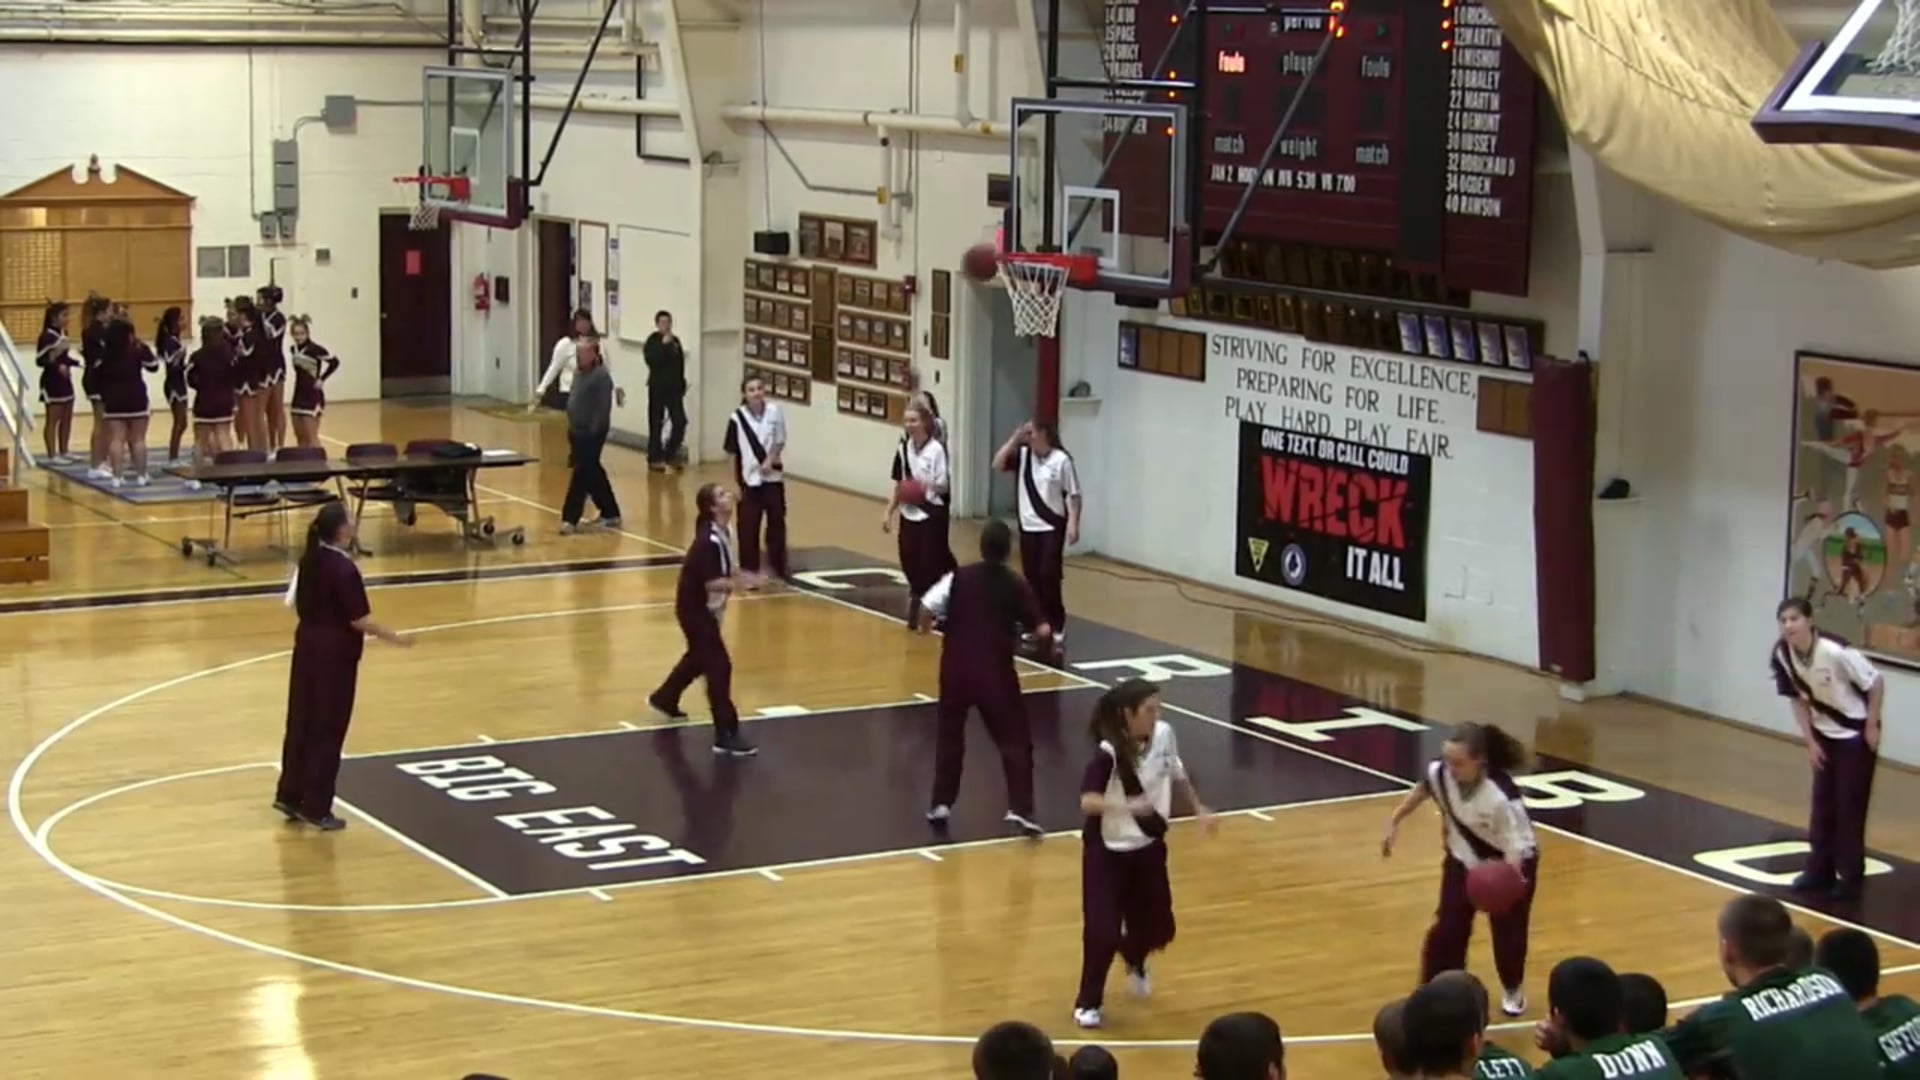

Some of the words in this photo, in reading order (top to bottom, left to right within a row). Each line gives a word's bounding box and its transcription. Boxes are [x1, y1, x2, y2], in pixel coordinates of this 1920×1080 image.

[1465, 27, 1503, 47] MARTIN
[1218, 50, 1246, 73] fouls
[1361, 55, 1391, 78] fouls
[1450, 69, 1463, 88] 20
[1464, 70, 1501, 90] BRALEY
[1449, 90, 1462, 109] 22
[1464, 90, 1500, 111] MARTIN
[1214, 133, 1245, 154] match
[1280, 136, 1318, 161] weight
[1355, 144, 1390, 165] match
[1445, 173, 1458, 192] 34
[1459, 175, 1491, 194] OGDEN
[1445, 194, 1459, 214] 40
[1460, 195, 1501, 217] RAWSON
[1211, 333, 1288, 366] STRIVING
[1301, 347, 1336, 374] FOR
[1350, 355, 1477, 400] EXCELLENCE,
[1236, 367, 1333, 405] PREPARING
[1345, 386, 1380, 413] FOR
[1396, 394, 1445, 425] LIFE.
[1224, 396, 1267, 423] PLAY
[1345, 417, 1392, 447] PLAY
[1261, 429, 1284, 450] ONE
[1287, 434, 1317, 457] TEXT
[1318, 439, 1335, 460] OR
[1337, 443, 1365, 467] CALL
[1367, 450, 1409, 475] COULD
[1259, 455, 1409, 550] WRECK
[1345, 545, 1367, 581] IT
[1368, 551, 1405, 591] ALL
[394, 755, 558, 802] BIG
[493, 804, 707, 872] EAST
[1740, 972, 1846, 1022] RICHARDSON
[1592, 1039, 1668, 1080] DUNN
